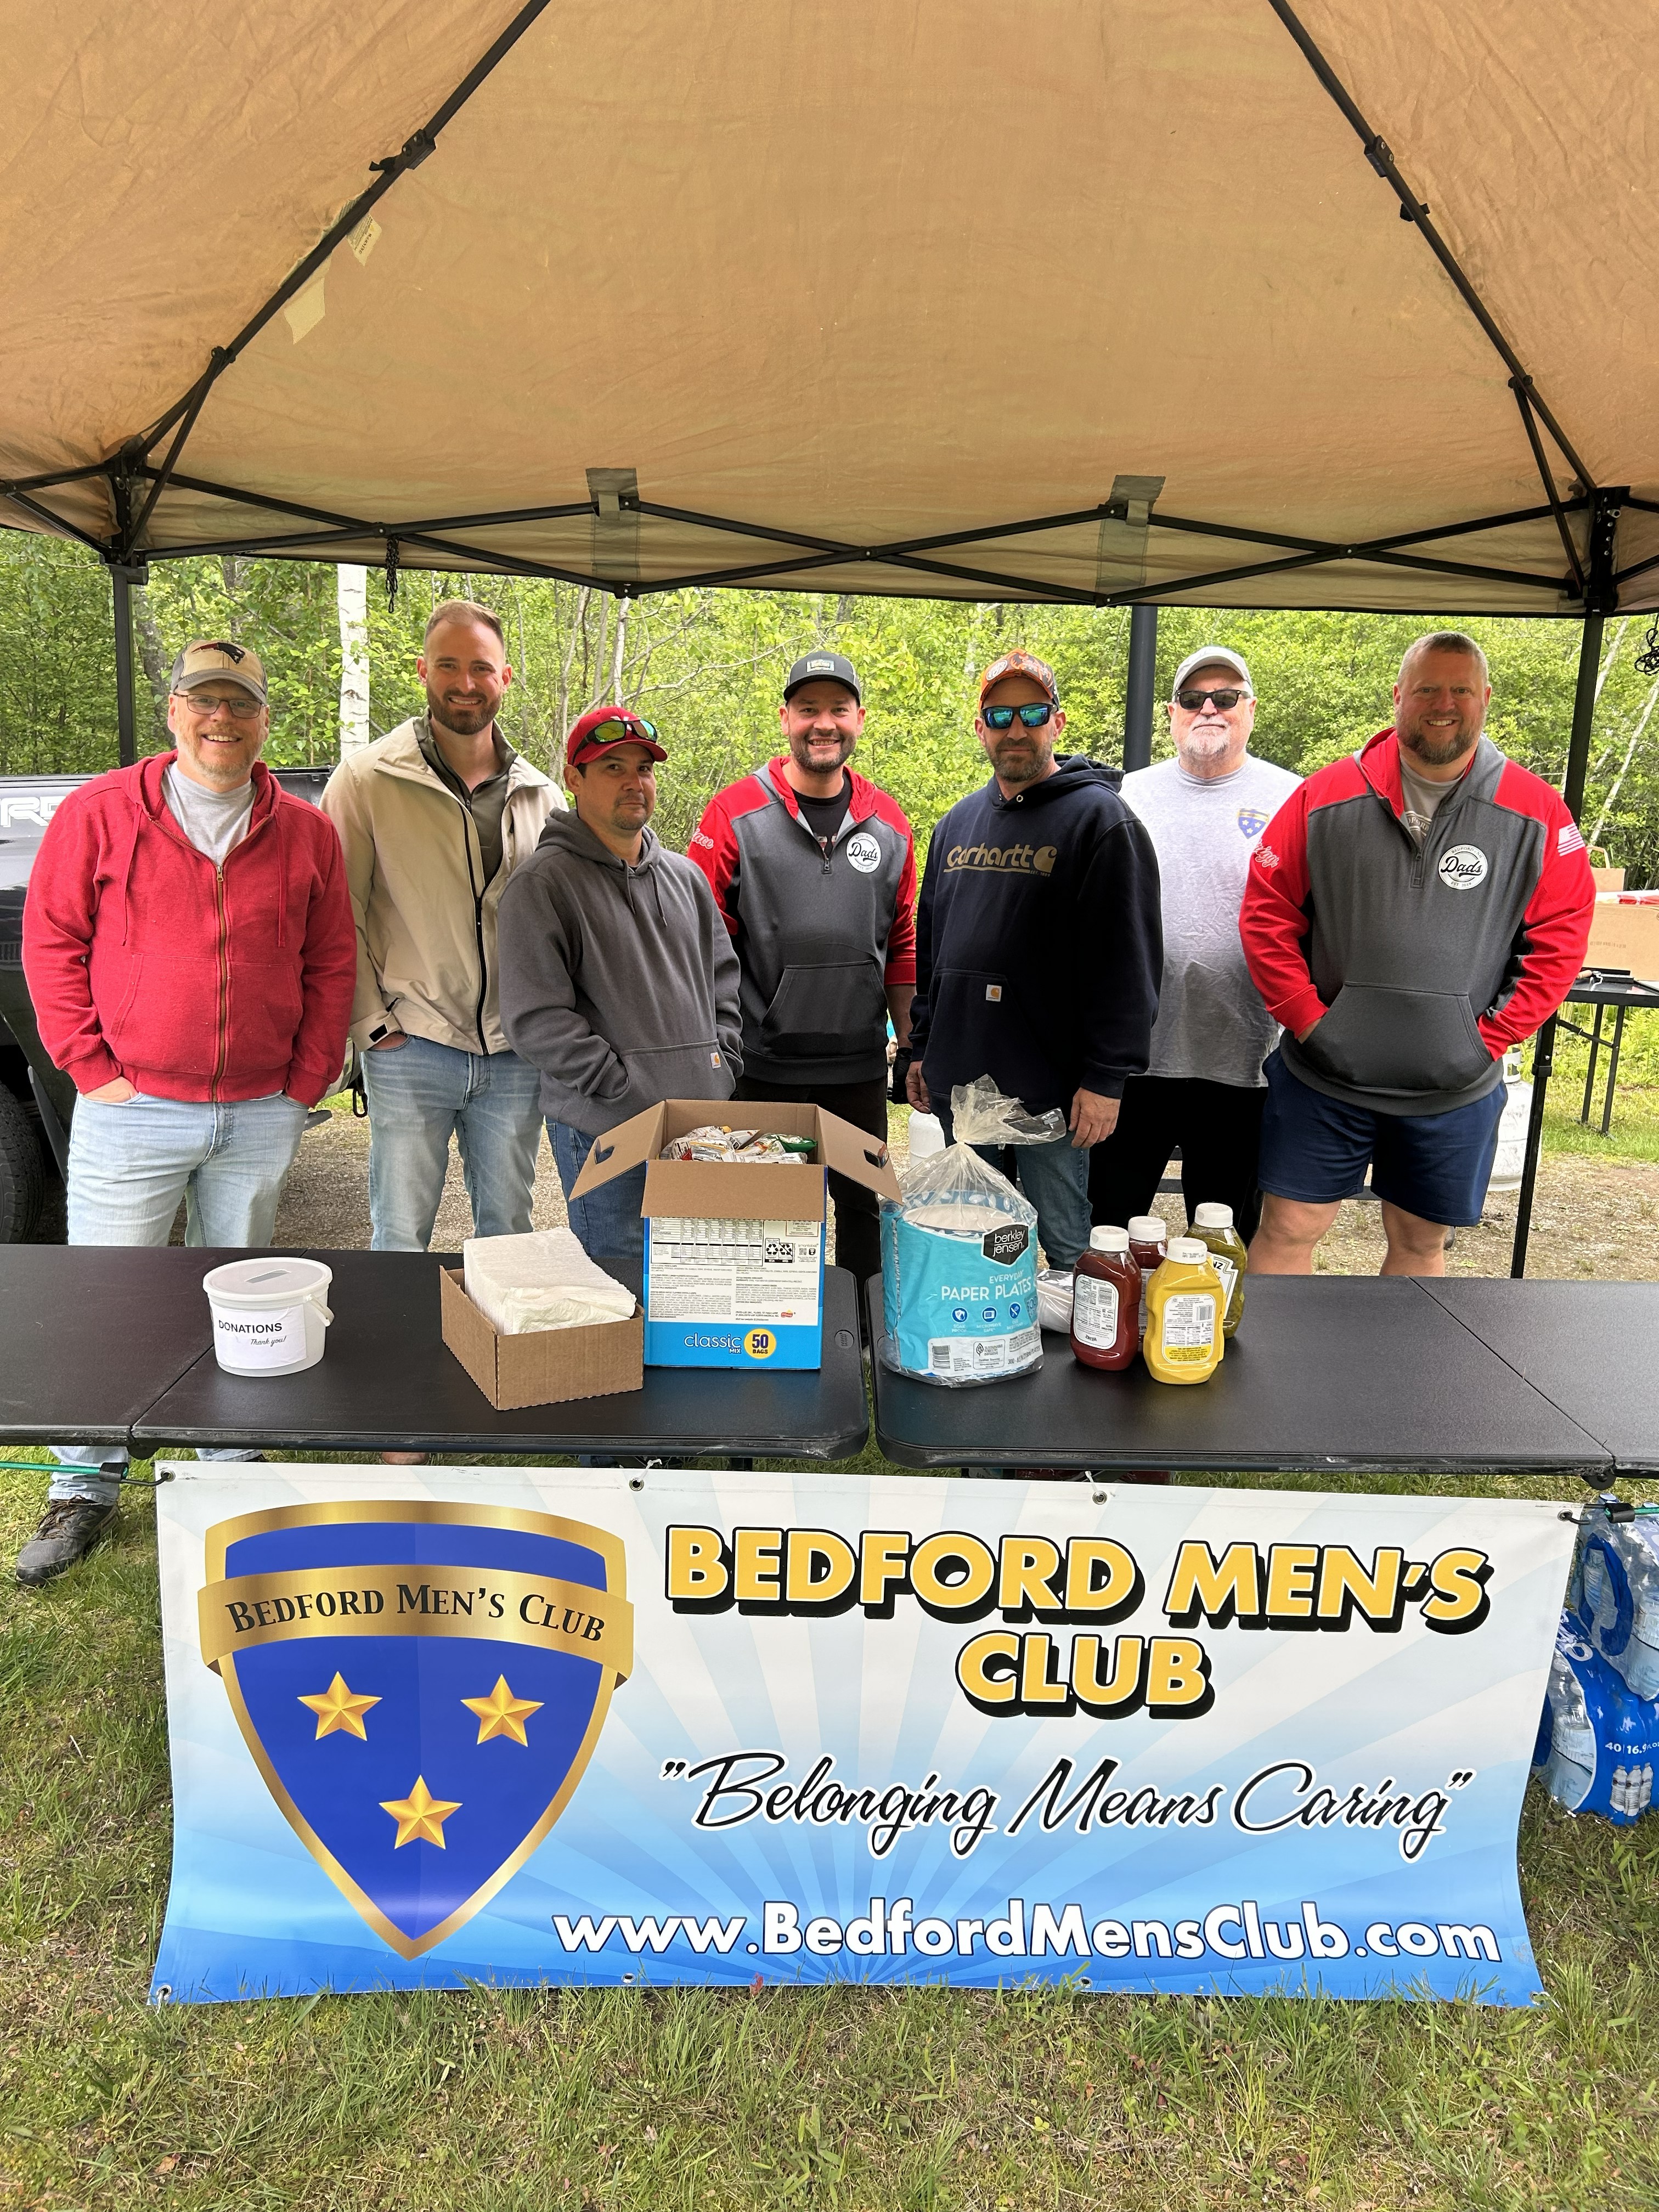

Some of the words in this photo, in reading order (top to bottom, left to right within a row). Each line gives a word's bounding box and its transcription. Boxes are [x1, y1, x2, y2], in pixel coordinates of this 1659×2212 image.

[848, 842, 878, 862] Dads
[1441, 856, 1483, 877] Dads
[994, 1229, 1025, 1244] berkley
[992, 1241, 1023, 1257] jensen
[989, 1269, 1024, 1284] EVERYDAY
[941, 1285, 990, 1301] PAPER
[995, 1276, 1031, 1300] PLATES
[218, 1320, 283, 1334] DONATIONS
[270, 1335, 287, 1347] you!
[684, 1333, 742, 1348] classic
[752, 1334, 769, 1348] 50
[665, 1525, 1144, 1625] BEDFORD
[1163, 1540, 1494, 1635] MEN'S
[955, 1630, 1215, 1719] CLUB
[1605, 1742, 1622, 1752] 40
[1627, 1743, 1647, 1754] 16.9
[1007, 1758, 1226, 1833] Means
[551, 1897, 1502, 1962] www.BedfordMensClub.com
